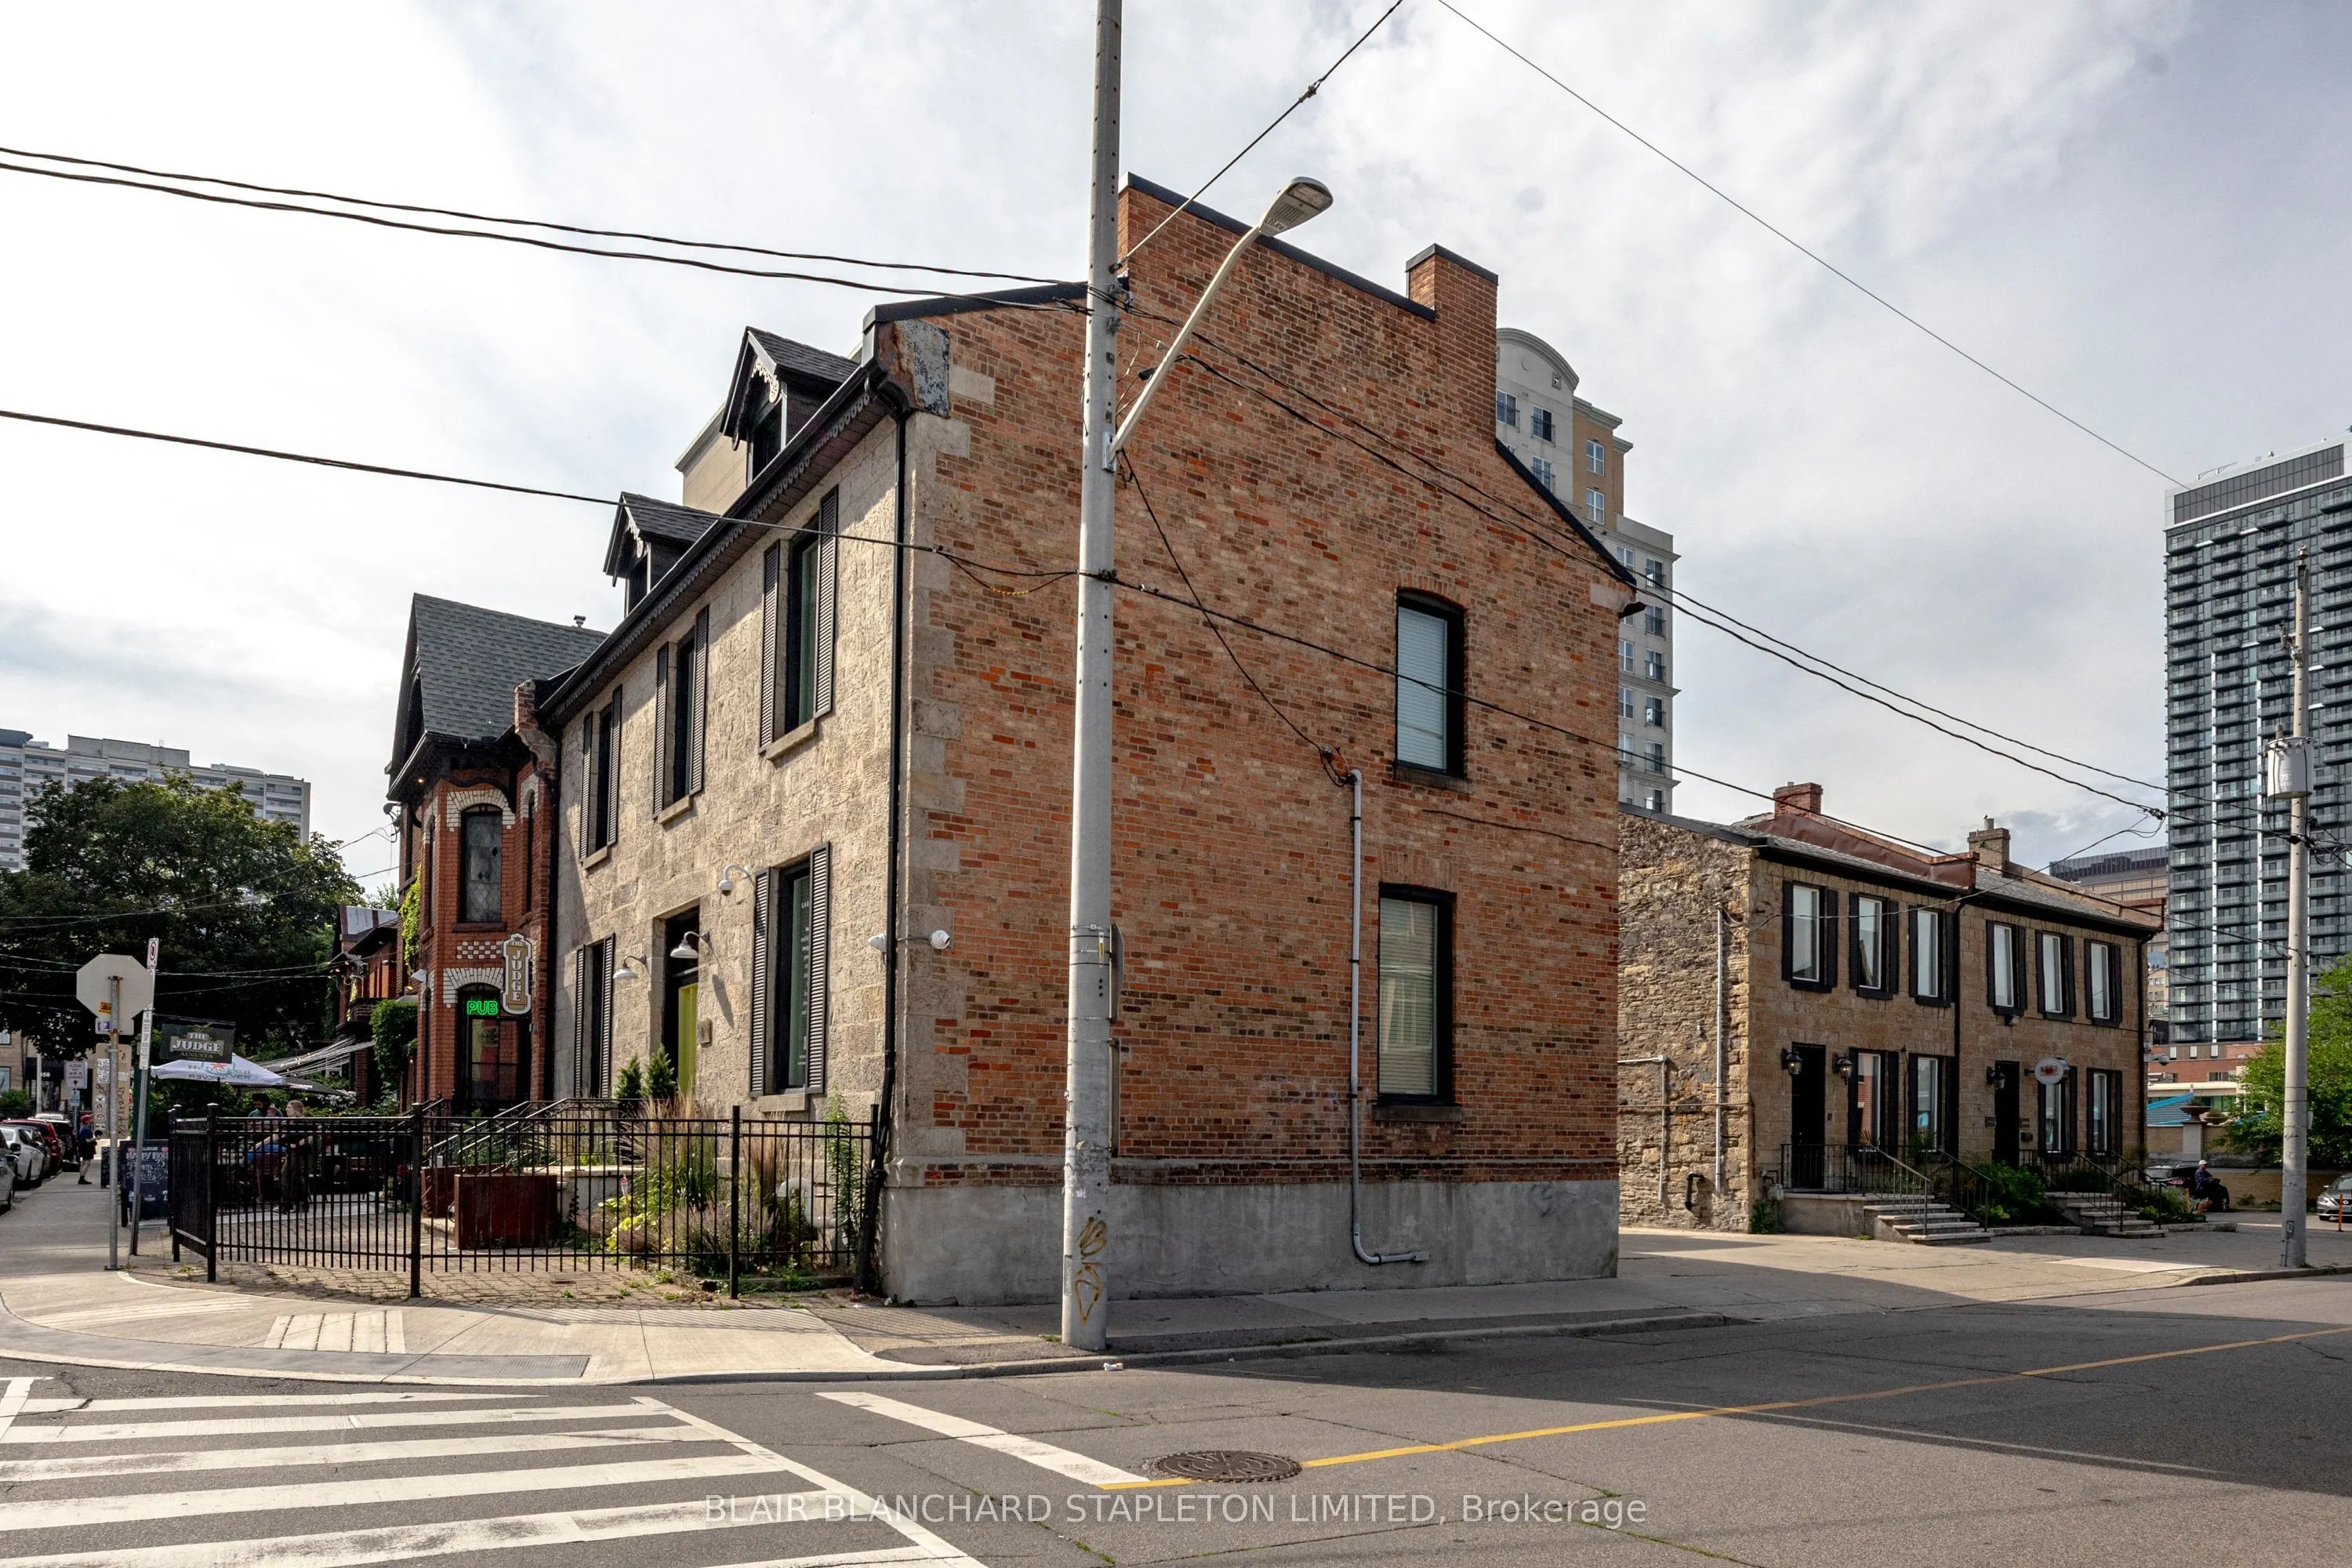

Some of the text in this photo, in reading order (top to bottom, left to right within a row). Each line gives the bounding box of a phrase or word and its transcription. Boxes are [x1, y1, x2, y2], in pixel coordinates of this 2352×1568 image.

[511, 949, 522, 1001] JUDGE
[466, 1000, 499, 1015] PUB
[172, 1040, 221, 1051] JUDGE
